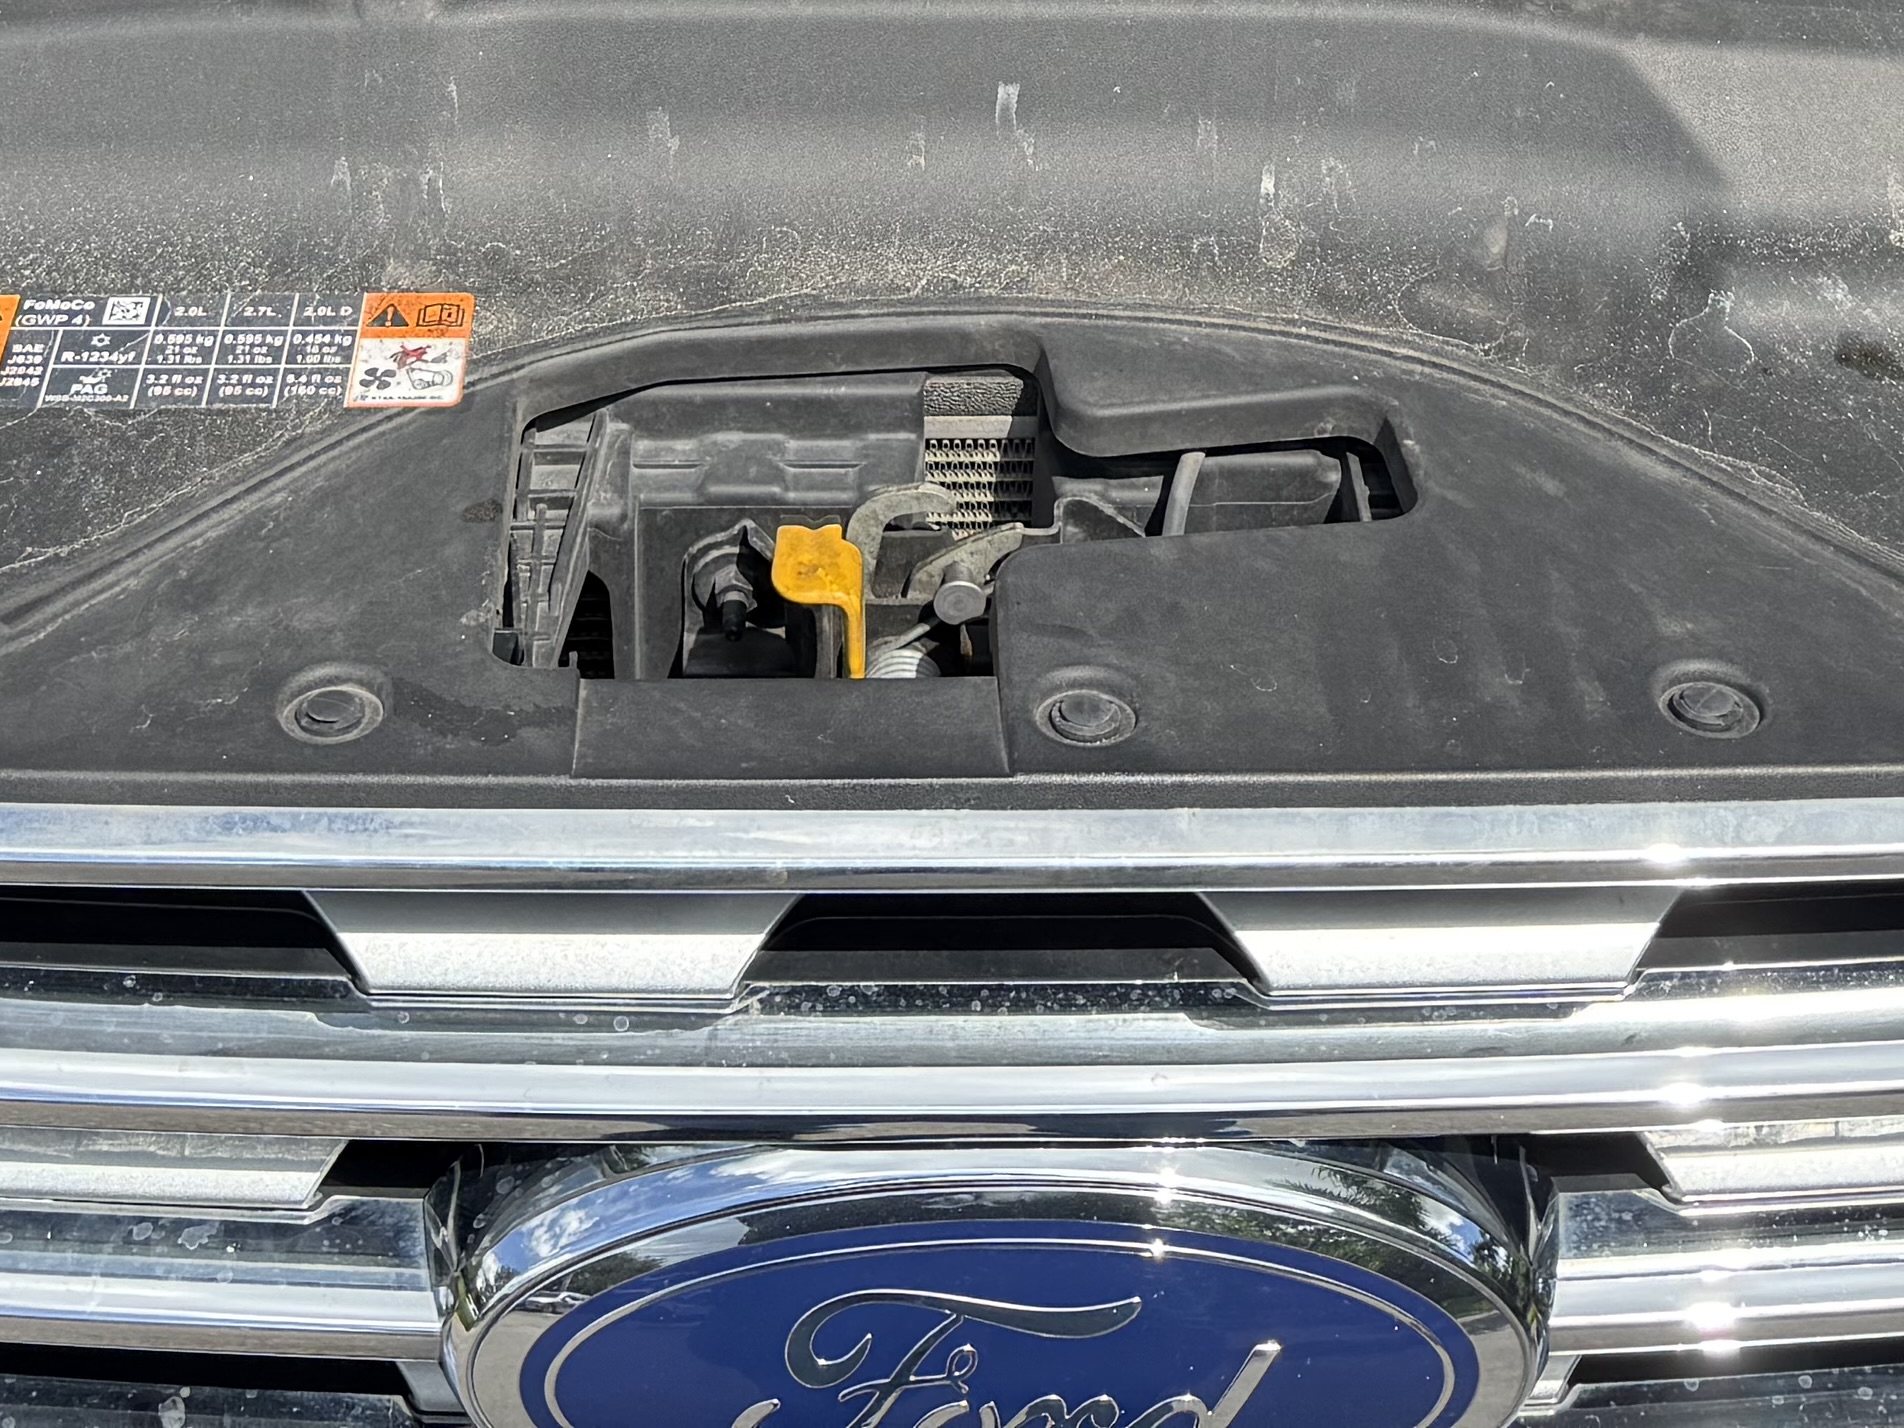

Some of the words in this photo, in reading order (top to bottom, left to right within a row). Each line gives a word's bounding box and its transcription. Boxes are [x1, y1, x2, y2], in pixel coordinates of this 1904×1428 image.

[22, 297, 96, 310] FoMoCo
[174, 306, 207, 316] 2.0L
[243, 306, 277, 316] 2.7L
[303, 306, 336, 316] 2.0L
[340, 306, 353, 316] D
[14, 314, 67, 327] (GWP
[71, 314, 91, 327] 4)
[195, 334, 215, 347] kg
[265, 334, 284, 347] kg
[292, 333, 332, 344] 0.454
[334, 334, 353, 347] kg
[60, 350, 137, 364] R-1234yf
[146, 374, 167, 384] 3.2
[184, 375, 204, 384] oz
[217, 374, 239, 384] 3.2
[255, 375, 274, 384] oz
[324, 375, 342, 384] oz
[70, 383, 108, 394] PAG
[176, 386, 198, 397] cc)
[245, 386, 268, 397] cc)
[318, 386, 343, 397] cc)
